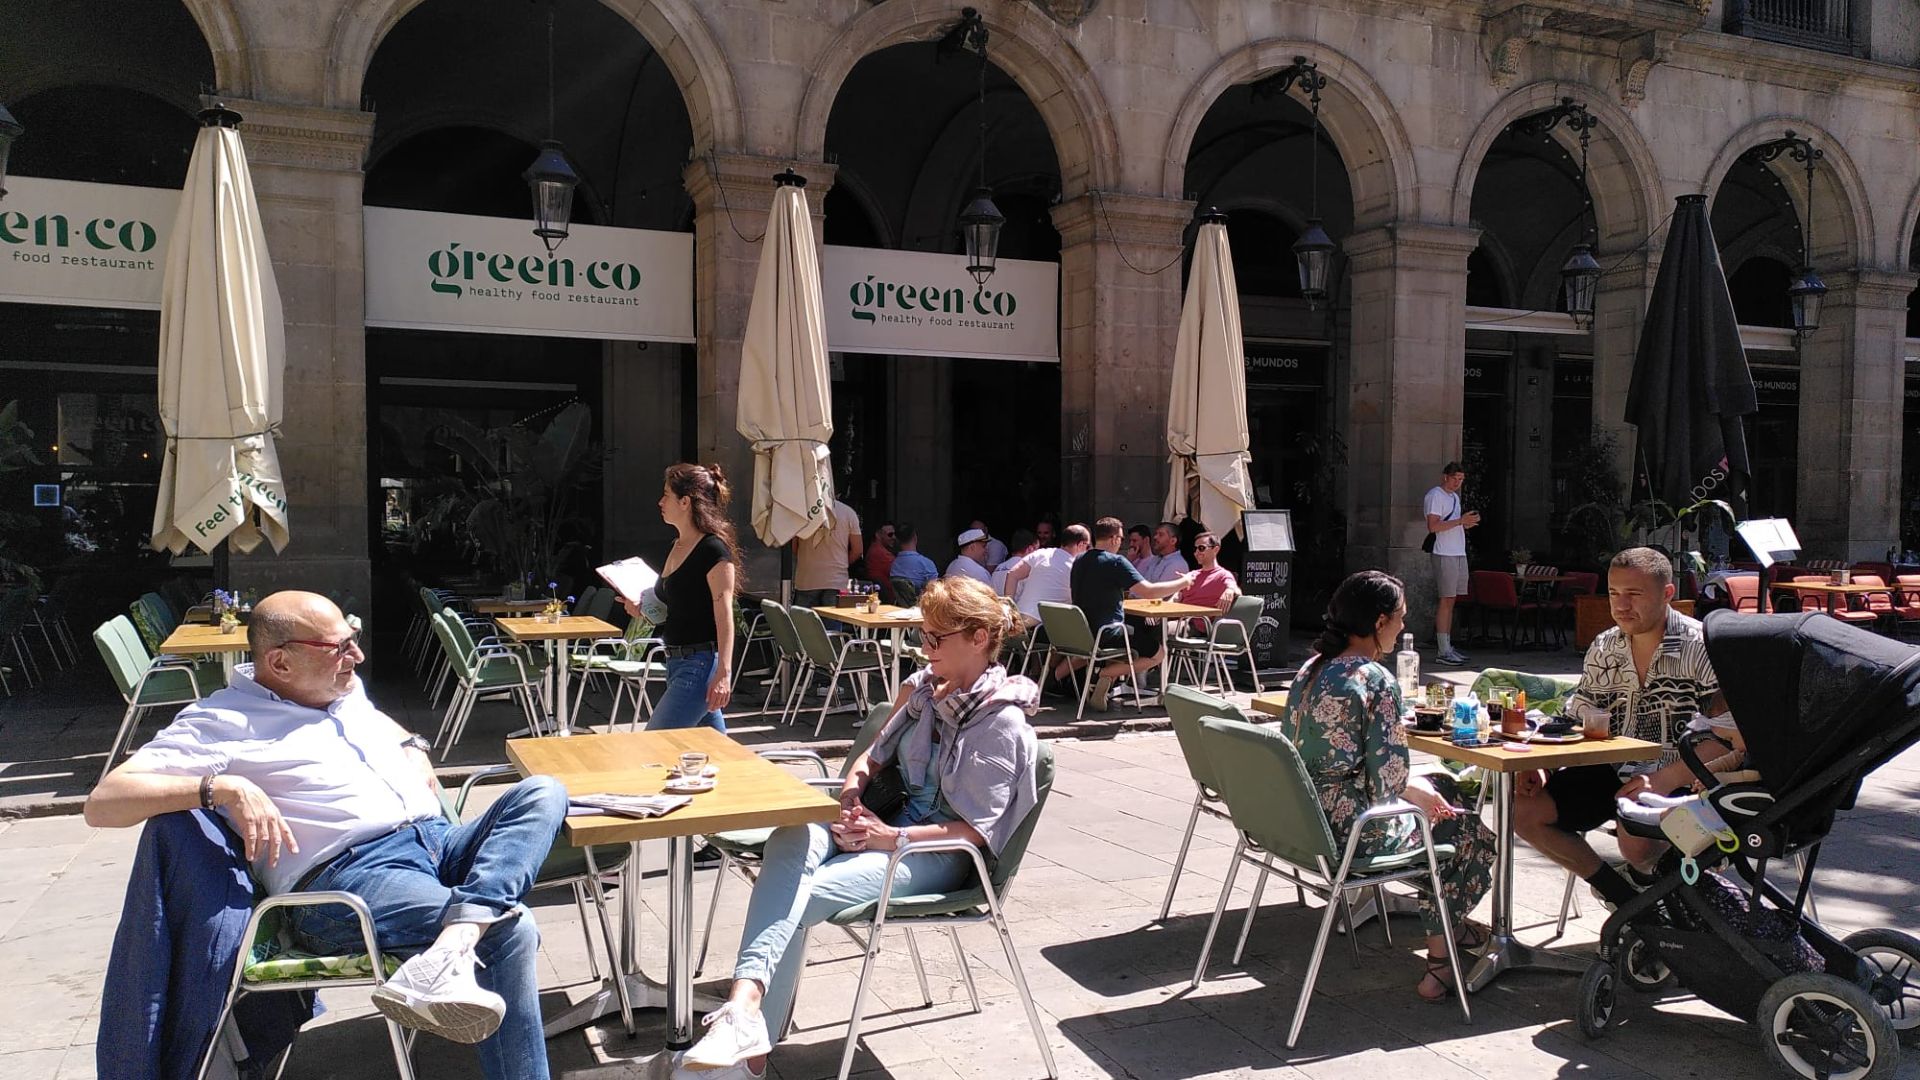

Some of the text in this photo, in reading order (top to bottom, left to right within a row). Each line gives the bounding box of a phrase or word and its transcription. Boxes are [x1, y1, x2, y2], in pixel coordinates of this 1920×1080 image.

[13, 250, 155, 271] food restaurant
[469, 286, 640, 306] healthy food restaurant
[881, 313, 1015, 330] healthy food restaurant
[1252, 356, 1299, 369] MUNDOS
[1764, 381, 1797, 391] MUNDOS
[195, 504, 231, 538] Feel
